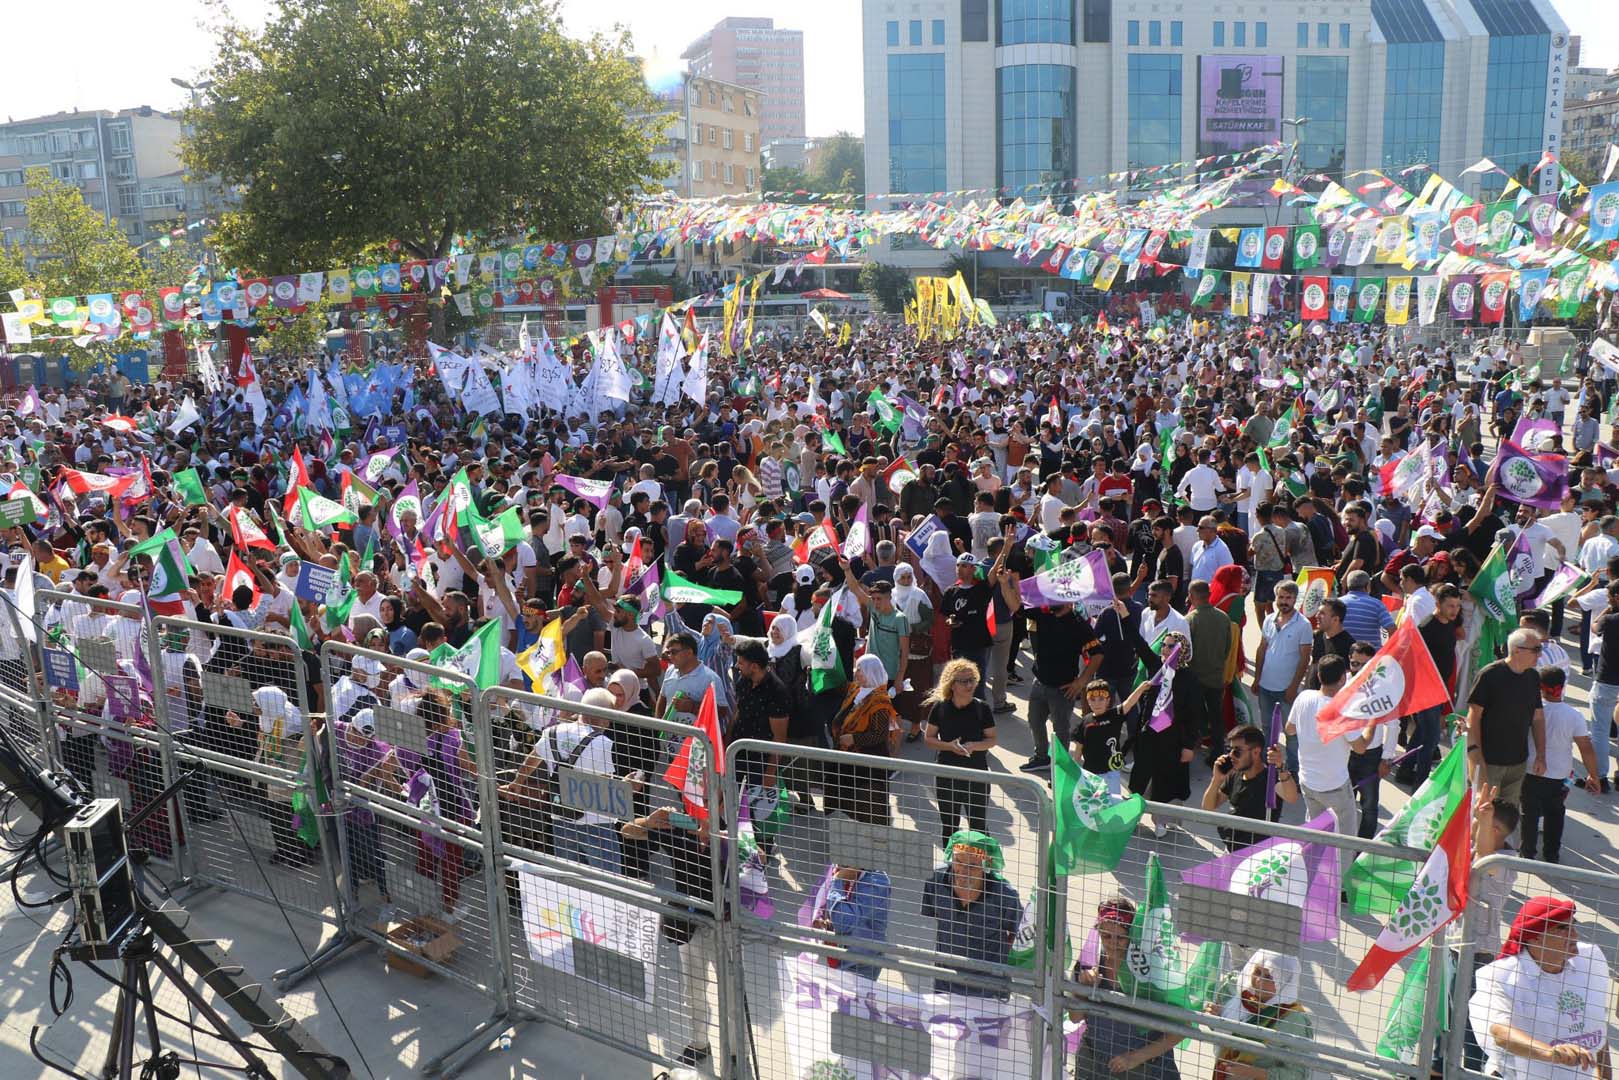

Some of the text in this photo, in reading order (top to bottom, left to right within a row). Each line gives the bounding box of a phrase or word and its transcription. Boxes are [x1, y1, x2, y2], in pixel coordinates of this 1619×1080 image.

[1550, 53, 1562, 119] KARTAL
[487, 543, 501, 557] HDP
[567, 775, 629, 818] POLİS
[1130, 942, 1151, 977] HDP
[1567, 1021, 1584, 1033] HDP
